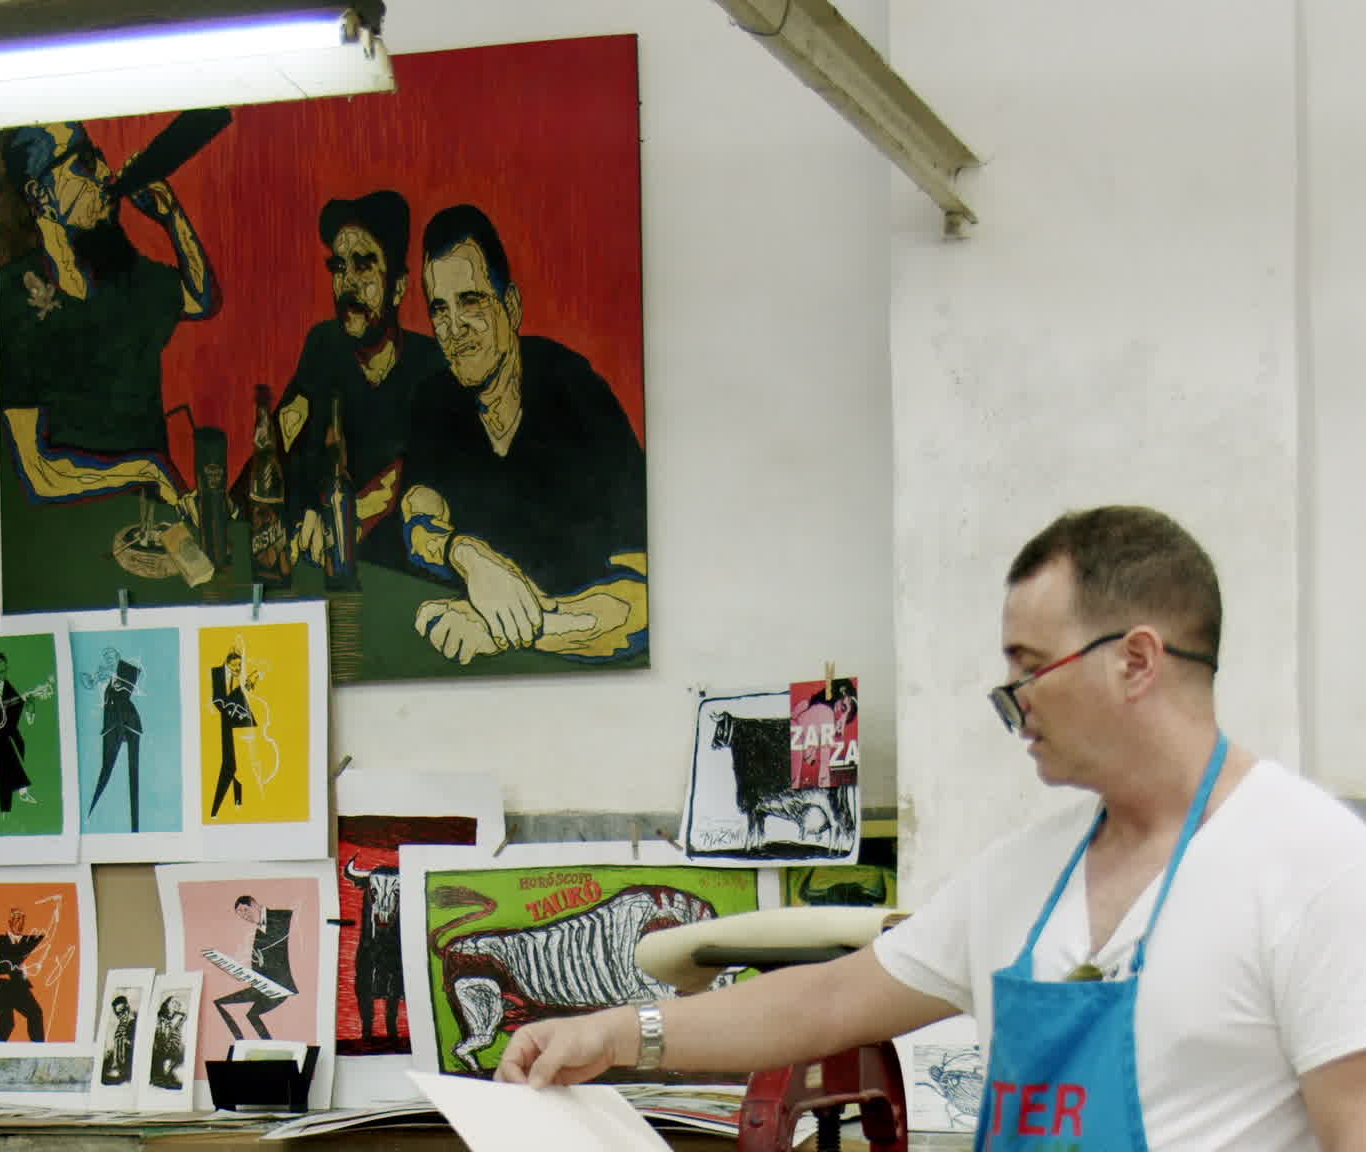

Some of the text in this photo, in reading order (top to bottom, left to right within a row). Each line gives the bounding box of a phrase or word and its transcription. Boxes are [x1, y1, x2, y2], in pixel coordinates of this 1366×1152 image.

[790, 724, 835, 751] ZAR
[828, 740, 859, 767] ZA
[525, 881, 602, 921] TAURO
